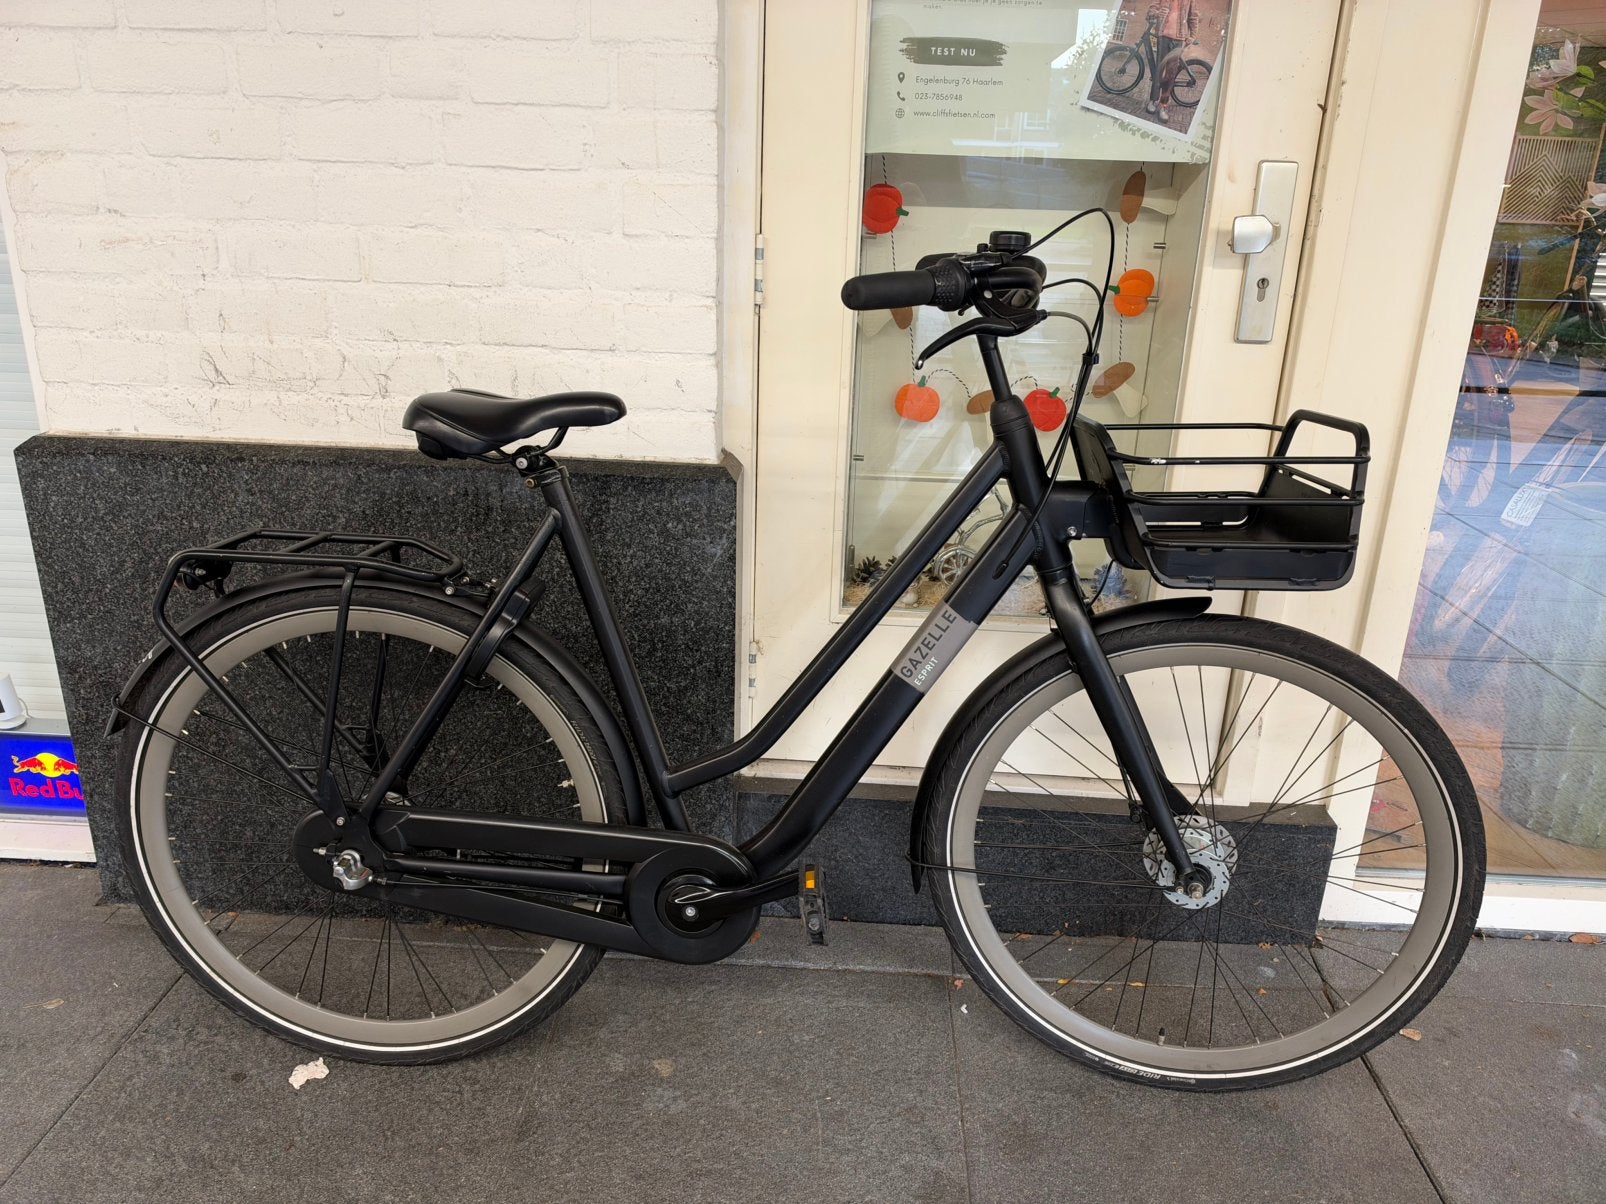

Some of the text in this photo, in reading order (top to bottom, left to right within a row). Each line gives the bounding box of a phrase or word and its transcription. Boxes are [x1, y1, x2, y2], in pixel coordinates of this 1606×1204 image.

[930, 47, 976, 56] TEST NU
[915, 76, 1004, 86] Engelenburg 76 Haarlem
[914, 92, 963, 101] 023-7856948
[900, 609, 957, 679] GAZELLE
[913, 656, 939, 685] ESPRIT
[9, 777, 85, 800] Red Bu
